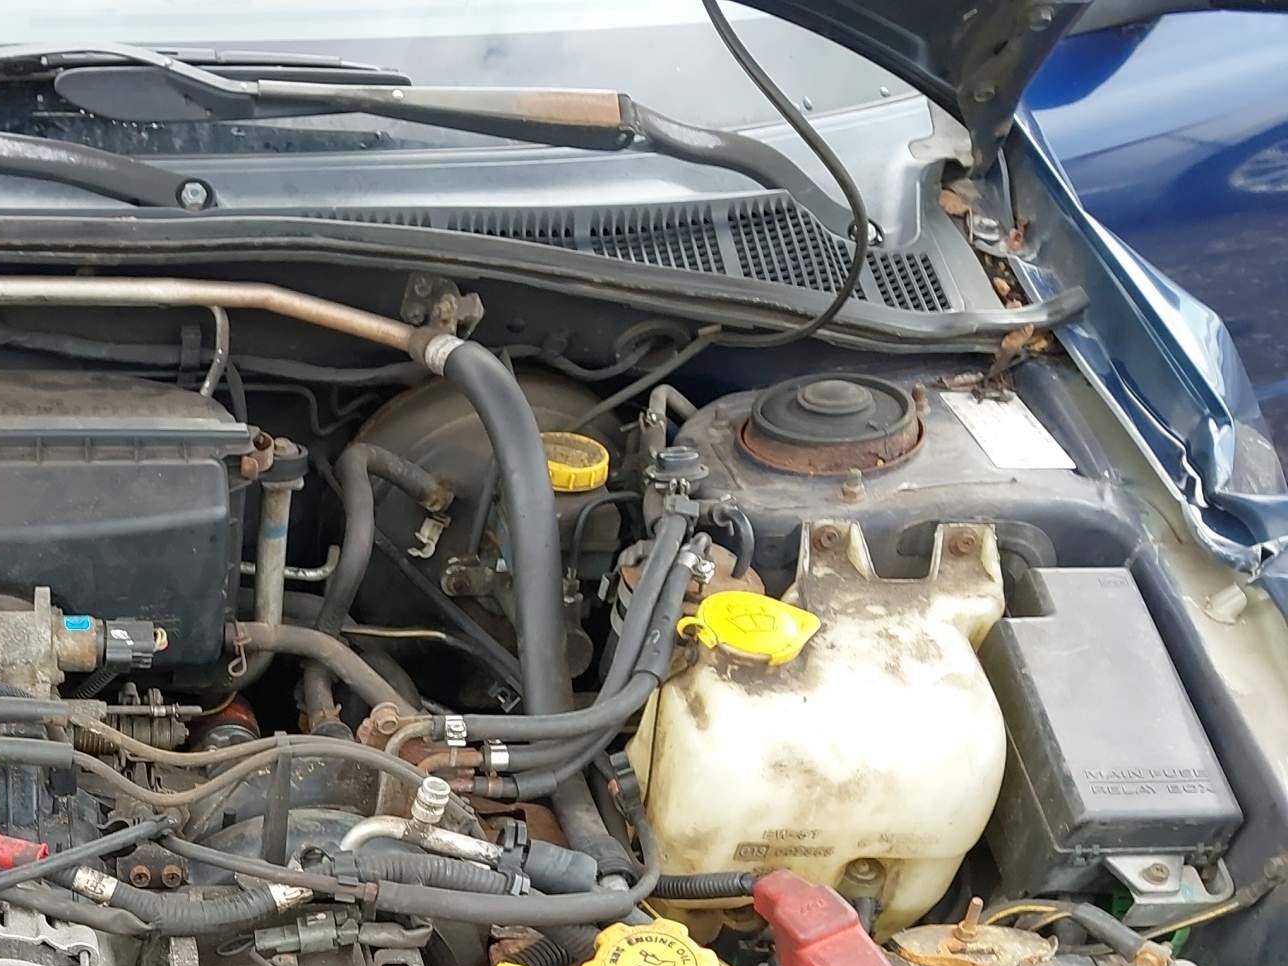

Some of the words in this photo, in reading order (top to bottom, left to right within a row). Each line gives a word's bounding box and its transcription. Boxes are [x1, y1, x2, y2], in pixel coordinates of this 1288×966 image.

[1084, 768, 1144, 779] MAIN
[1090, 783, 1158, 795] RELAY
[1166, 783, 1217, 794] BOX
[626, 935, 675, 949] ENGINE
[676, 948, 692, 966] OIL
